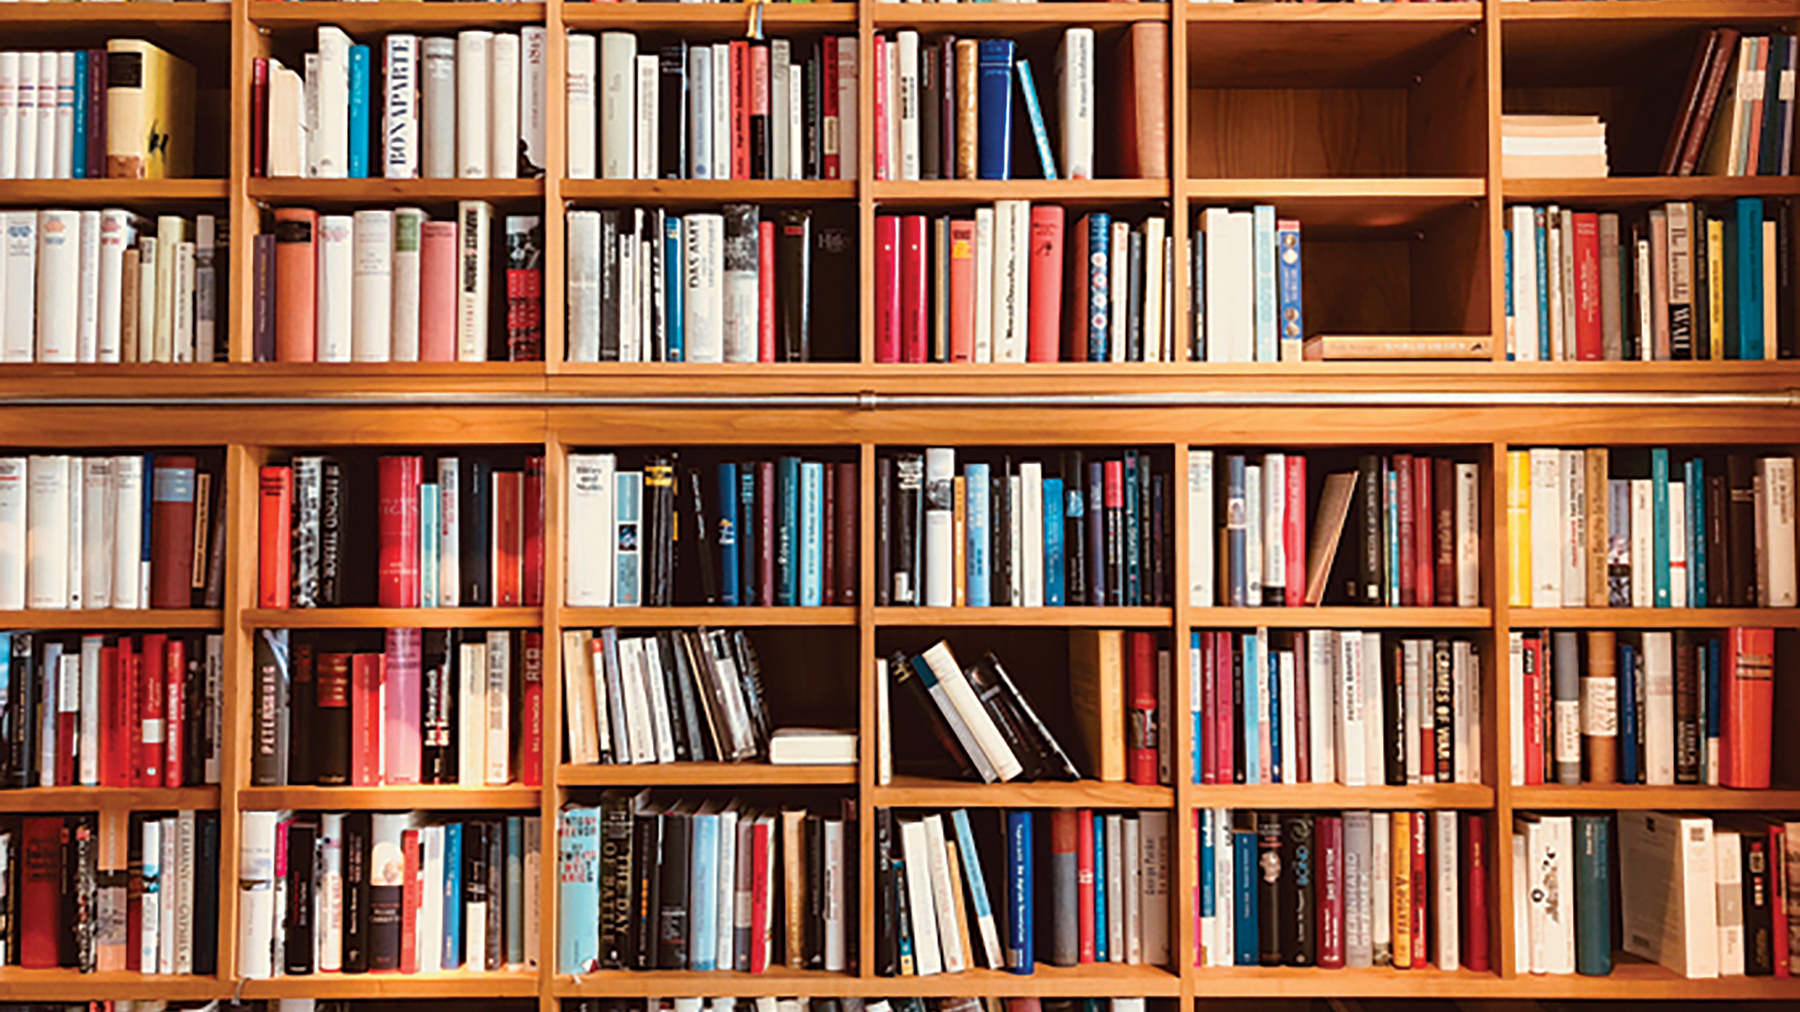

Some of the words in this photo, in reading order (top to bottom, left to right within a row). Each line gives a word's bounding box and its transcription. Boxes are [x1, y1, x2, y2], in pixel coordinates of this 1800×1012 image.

[389, 39, 409, 166] BONAPARTE
[1672, 227, 1687, 245] The
[526, 648, 540, 682] RED
[1436, 651, 1450, 703] CRIMES
[1436, 705, 1449, 724] OF
[1436, 726, 1450, 759] WAR
[603, 842, 616, 865] OF
[616, 854, 630, 892] THE
[603, 876, 616, 945] BATTLE
[616, 897, 629, 935] DAY
[1346, 852, 1358, 947] BERNHARD
